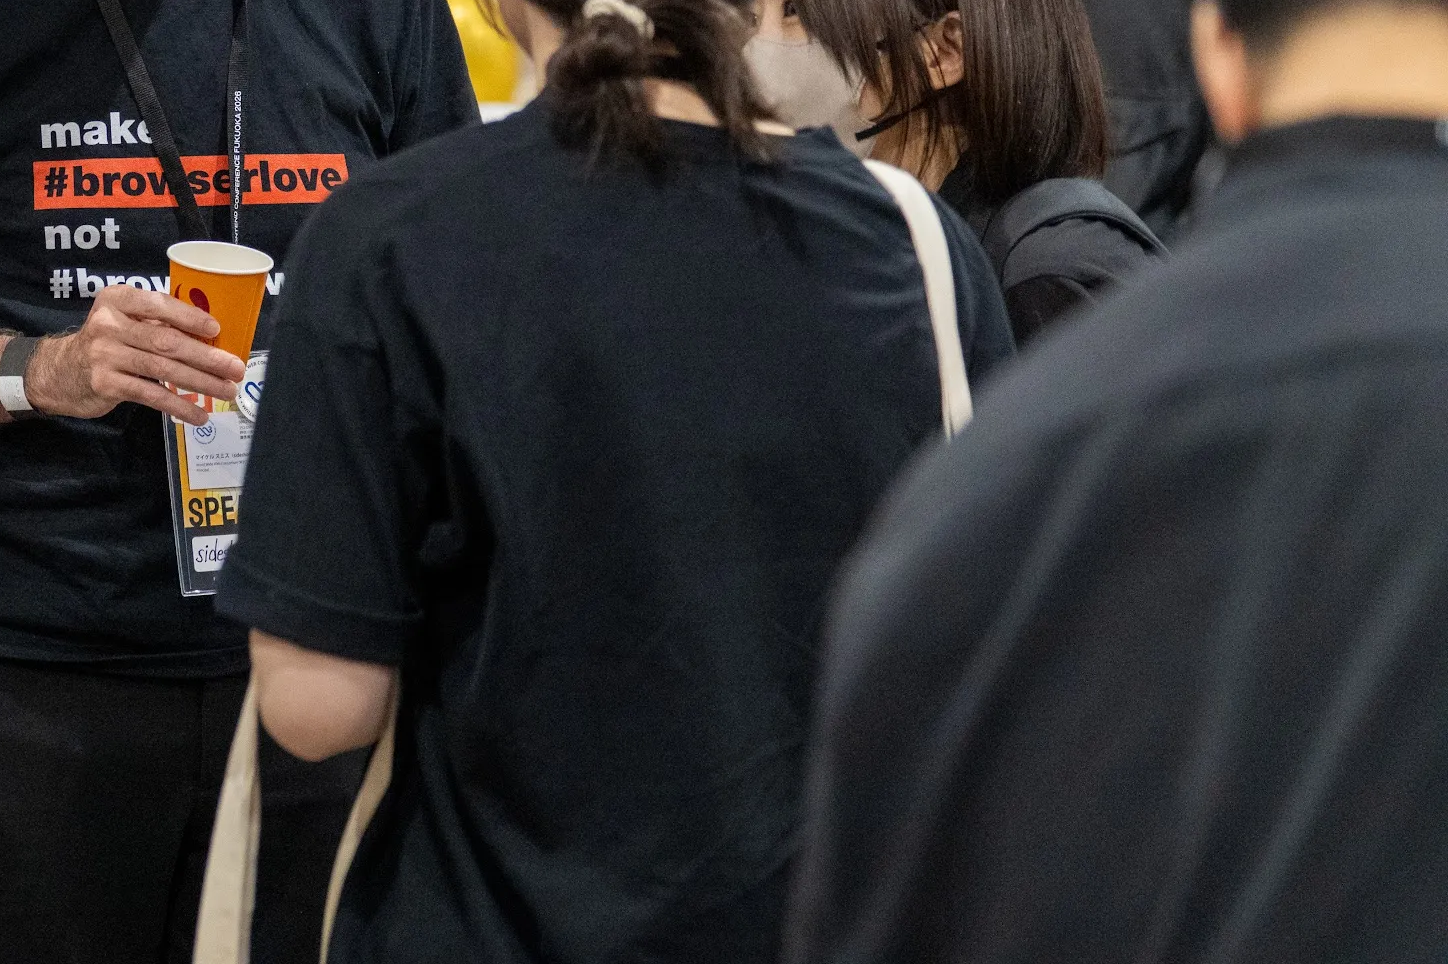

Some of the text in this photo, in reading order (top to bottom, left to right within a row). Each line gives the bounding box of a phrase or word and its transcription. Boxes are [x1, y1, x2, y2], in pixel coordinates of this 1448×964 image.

[234, 90, 242, 112] 2026
[234, 113, 242, 153] FUKUOKA
[44, 160, 342, 198] #browserlove
[233, 154, 241, 209] CONFERENCE
[45, 218, 120, 250] not
[188, 495, 236, 528] SPE
